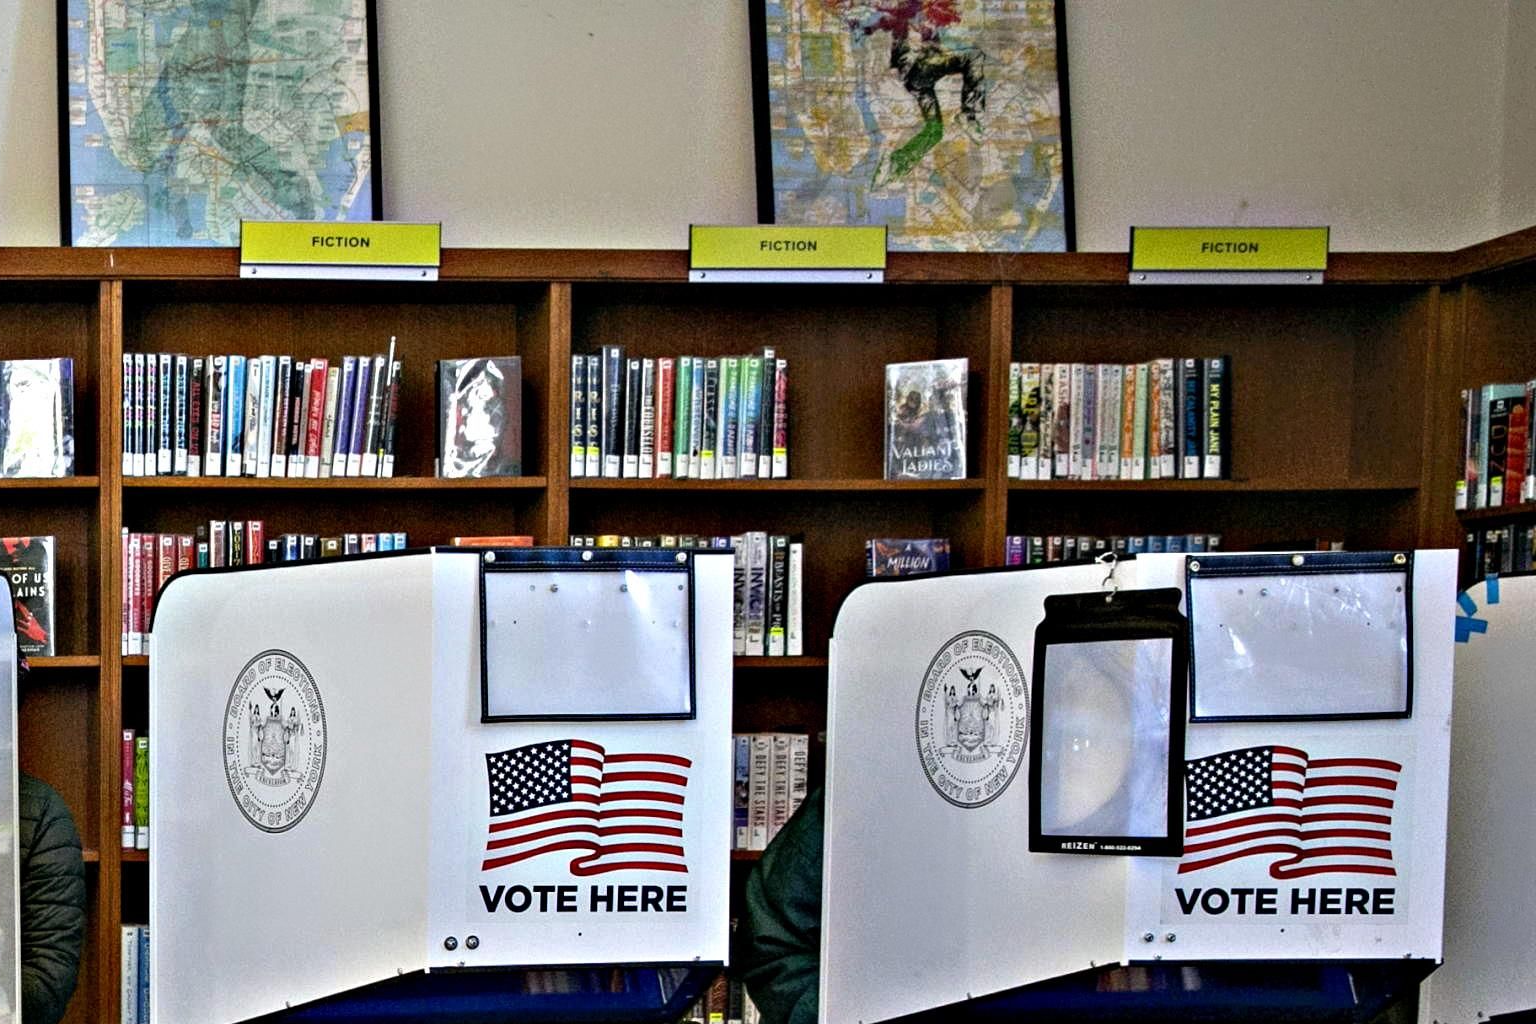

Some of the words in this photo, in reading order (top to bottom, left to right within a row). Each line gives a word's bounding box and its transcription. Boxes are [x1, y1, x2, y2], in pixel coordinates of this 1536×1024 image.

[312, 235, 371, 248] FICTION
[759, 240, 818, 252] FICTION
[1201, 242, 1259, 253] FICTION
[1209, 384, 1221, 398] MY
[1209, 400, 1221, 428] PLAIN
[642, 407, 654, 454] COUNSELO
[892, 441, 952, 459] VALIANT
[886, 556, 930, 570] MILLION
[12, 574, 28, 584] OF
[773, 561, 784, 602] BEASTS
[16, 586, 46, 598] AINS
[772, 613, 782, 628] PR
[756, 755, 766, 775] DEFY
[775, 755, 786, 775] DEFY
[794, 751, 805, 773] DEFY
[755, 780, 765, 795] THE
[775, 780, 786, 795] THE
[793, 778, 805, 792] THE
[754, 800, 765, 827] STARS
[775, 800, 785, 827] STARS
[1061, 842, 1096, 850] REIZEN
[480, 886, 576, 913] VOTE
[591, 885, 687, 912] HERE
[1177, 889, 1277, 915] VOTE
[1291, 888, 1395, 914] HERE
